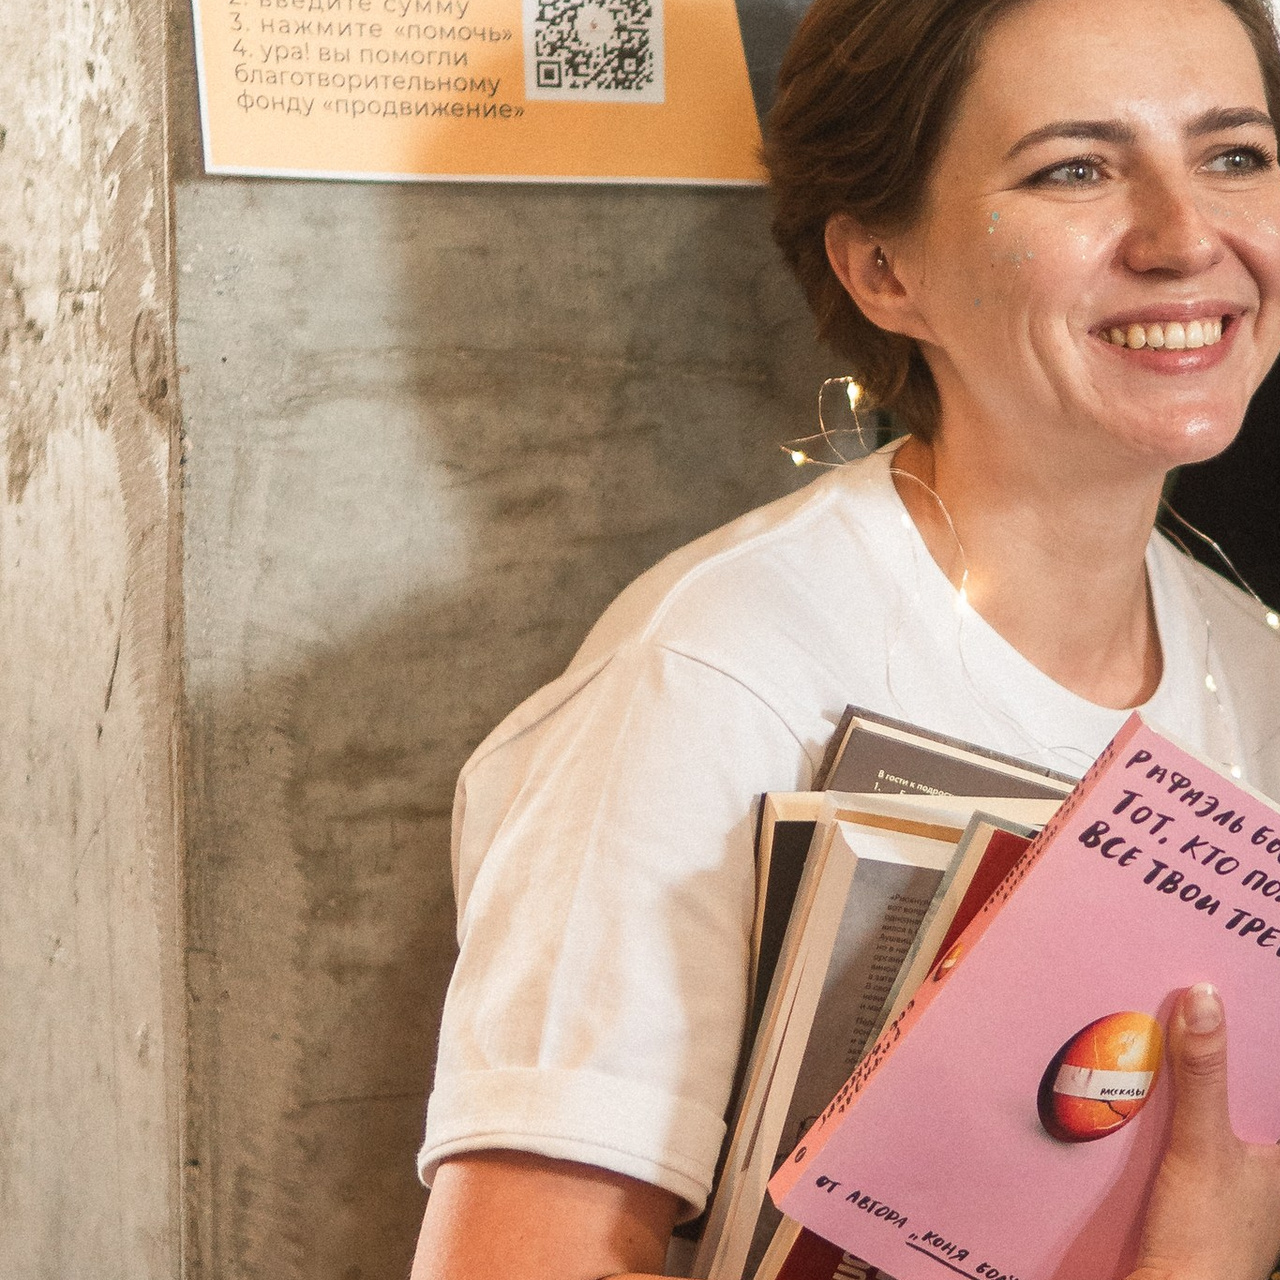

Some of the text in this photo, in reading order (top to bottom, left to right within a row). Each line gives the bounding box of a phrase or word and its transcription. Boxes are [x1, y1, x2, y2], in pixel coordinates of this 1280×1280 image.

[229, 12, 513, 42] 3. нажмите «помочь»
[232, 38, 468, 67] 4. ура! вы помогли
[234, 62, 501, 96] благотворительному
[236, 88, 526, 118] фонду «продвижение»
[885, 773, 908, 787] гости
[1125, 749, 1246, 834] РАФАЭЛЬ
[1078, 820, 1143, 867] ВСЕ
[1143, 858, 1221, 916] ТВОИ
[1179, 834, 1240, 876] КТО
[1100, 1087, 1146, 1097] РАССКАЗЫ
[815, 1175, 841, 1193] ОТ
[845, 1190, 908, 1229] АВТОРА
